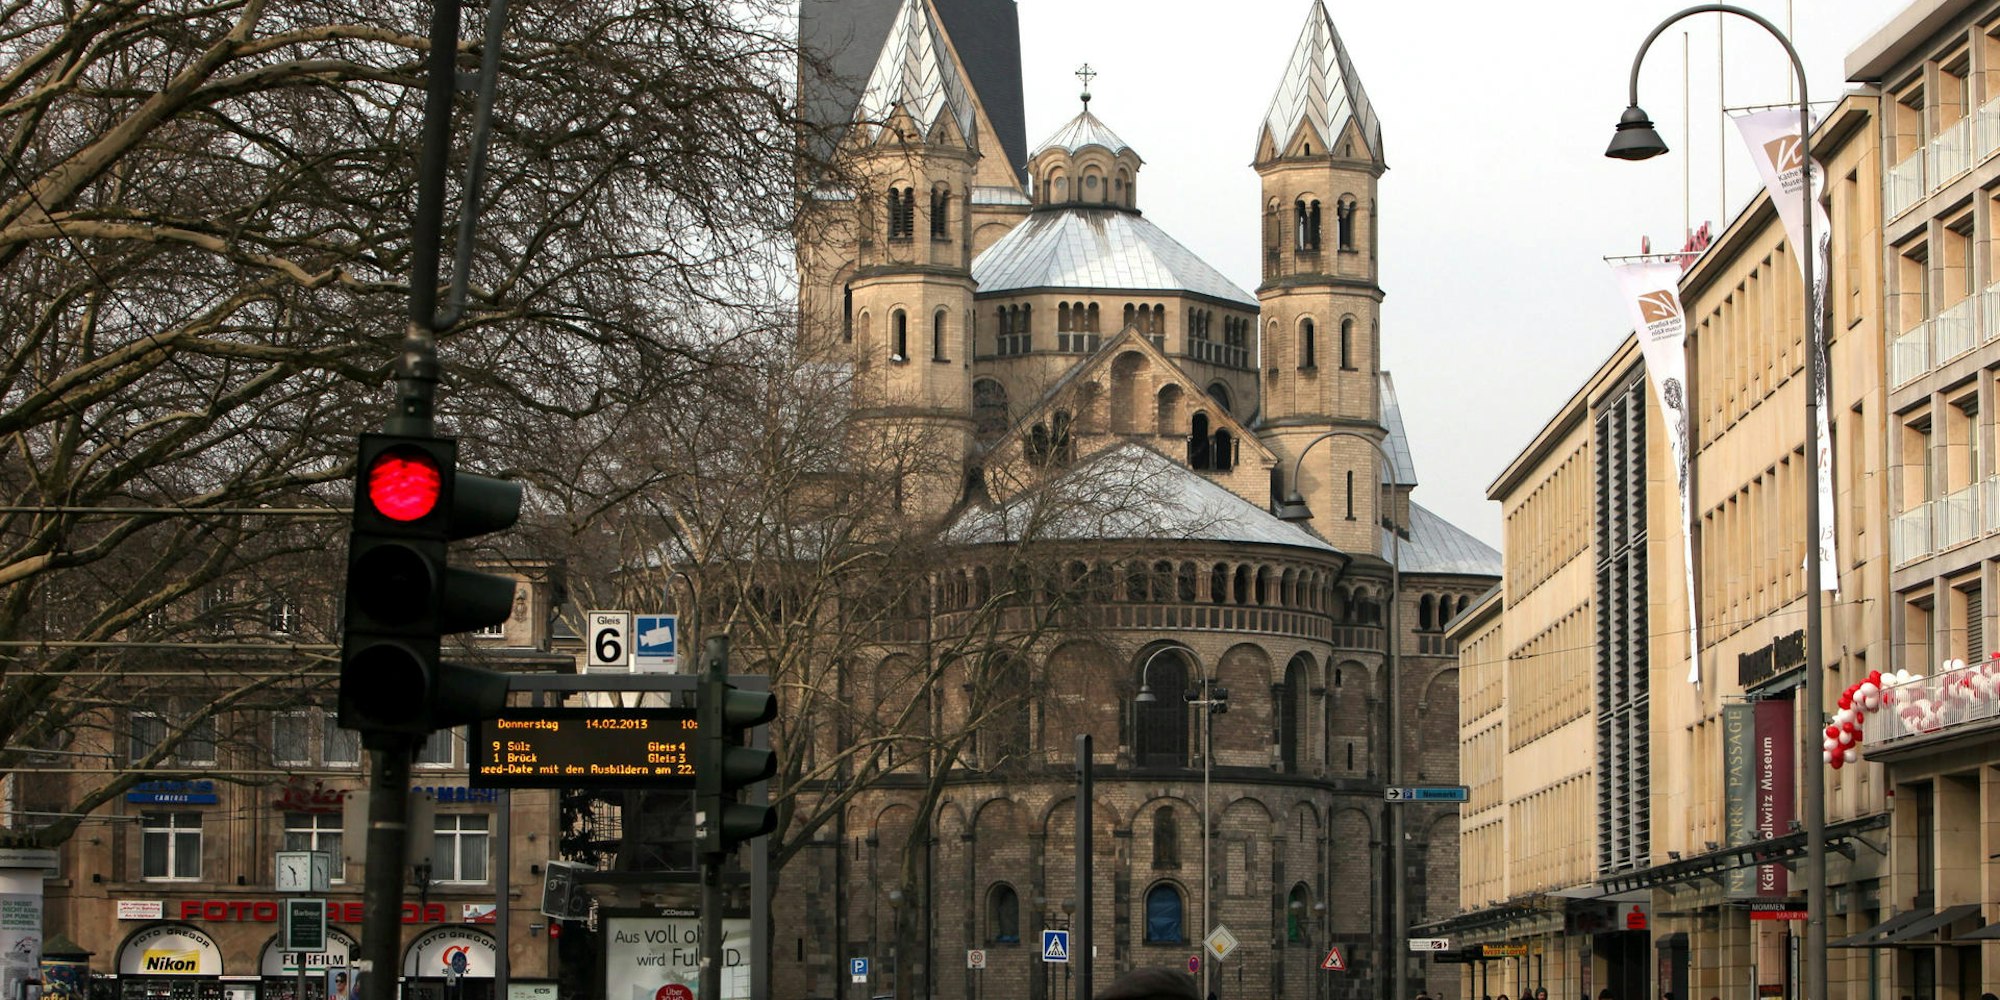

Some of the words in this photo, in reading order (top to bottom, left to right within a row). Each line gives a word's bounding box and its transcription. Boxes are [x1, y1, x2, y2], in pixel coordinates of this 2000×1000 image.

[1781, 178, 1804, 188] Museu
[597, 615, 621, 625] Gleis
[595, 628, 622, 663] 6
[498, 718, 559, 731] Donnerstag
[585, 719, 648, 729] 14.02.2013
[492, 741, 500, 751] 9
[507, 741, 531, 751] Sülz
[648, 741, 676, 752] Gleis
[678, 742, 686, 752] 4
[1728, 710, 1743, 787] PASSAGE
[493, 754, 499, 763] 1
[507, 753, 538, 763] Brück
[648, 753, 676, 763] Gleis
[678, 753, 686, 763] 3
[1760, 736, 1773, 791] Museum
[539, 765, 560, 775] mit
[565, 765, 585, 775] den
[590, 764, 649, 775] Ausbildern
[655, 766, 672, 775] am
[677, 765, 696, 775] 22.
[1760, 794, 1774, 840] ollwitz
[181, 901, 278, 921] FOTO
[326, 902, 446, 923] REOR
[293, 909, 320, 917] Barbour
[662, 909, 696, 917] JCDecaux
[1751, 903, 1786, 911] MOMMEN
[133, 929, 162, 948] FOTO
[166, 928, 211, 949] GREGOR
[615, 930, 640, 943] Aus
[645, 925, 679, 944] voll
[416, 931, 447, 951] FOTO
[449, 931, 497, 952] GREGOR
[147, 957, 196, 971] Nikon
[283, 954, 344, 965] FUIFILM
[637, 953, 666, 967] wird
[672, 948, 700, 967] Ful
[854, 960, 865, 973] P
[666, 987, 684, 997] Über
